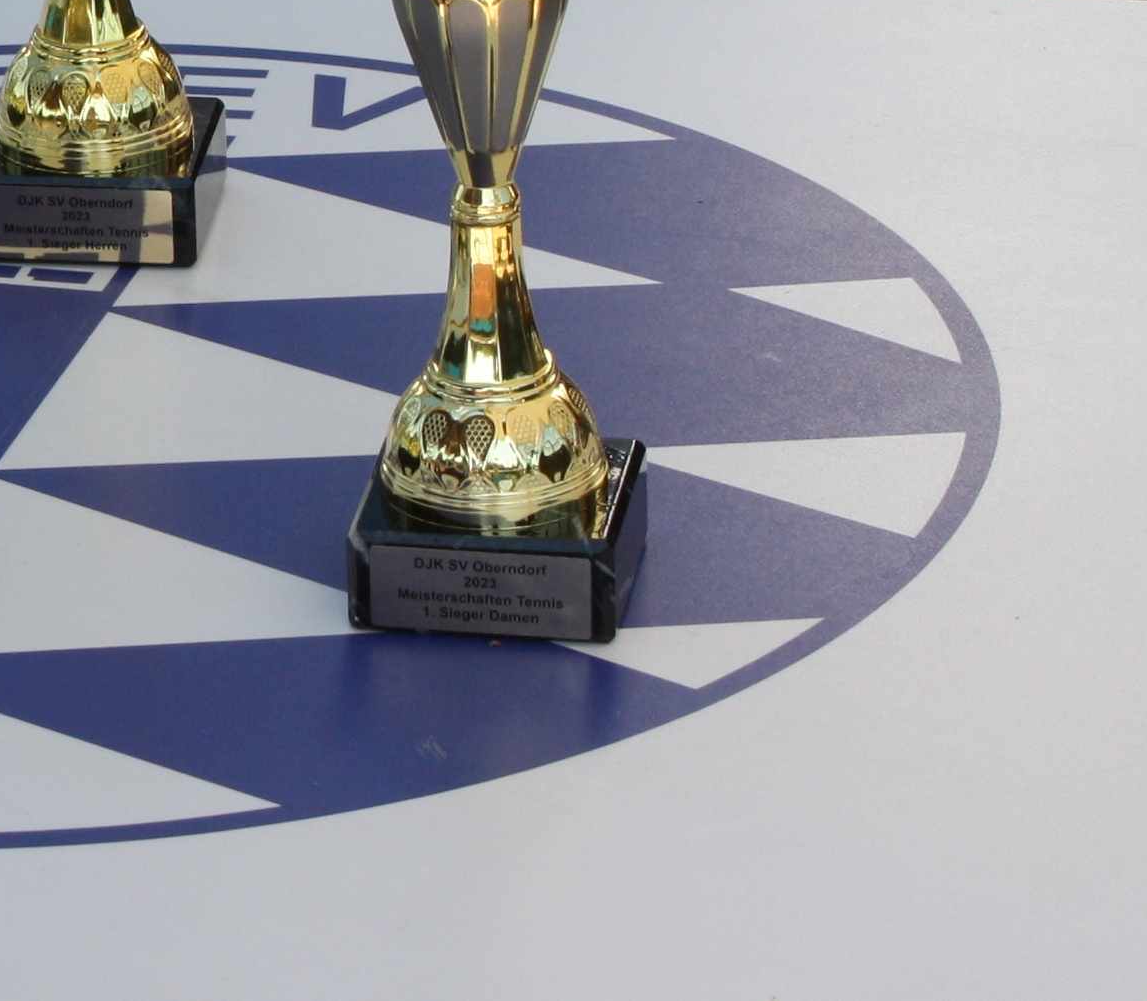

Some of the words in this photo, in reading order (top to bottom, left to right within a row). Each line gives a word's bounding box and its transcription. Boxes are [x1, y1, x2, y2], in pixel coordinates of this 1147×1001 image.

[18, 195, 44, 206] DJK
[48, 196, 65, 206] SV
[69, 197, 134, 208] Oberndorf
[62, 212, 90, 222] 2023
[5, 224, 103, 236] Meisterschaften
[109, 227, 149, 238] Tennis
[42, 240, 81, 251] Sieger
[86, 241, 127, 251] Herren
[414, 558, 444, 570] DJK
[450, 559, 468, 571] SV
[473, 561, 547, 576] Oberndorf
[464, 577, 497, 589] 2023
[398, 589, 512, 606] Meisterschaften
[517, 595, 563, 609] Tennis
[440, 608, 485, 623] Sieger
[489, 611, 539, 624] Damen
